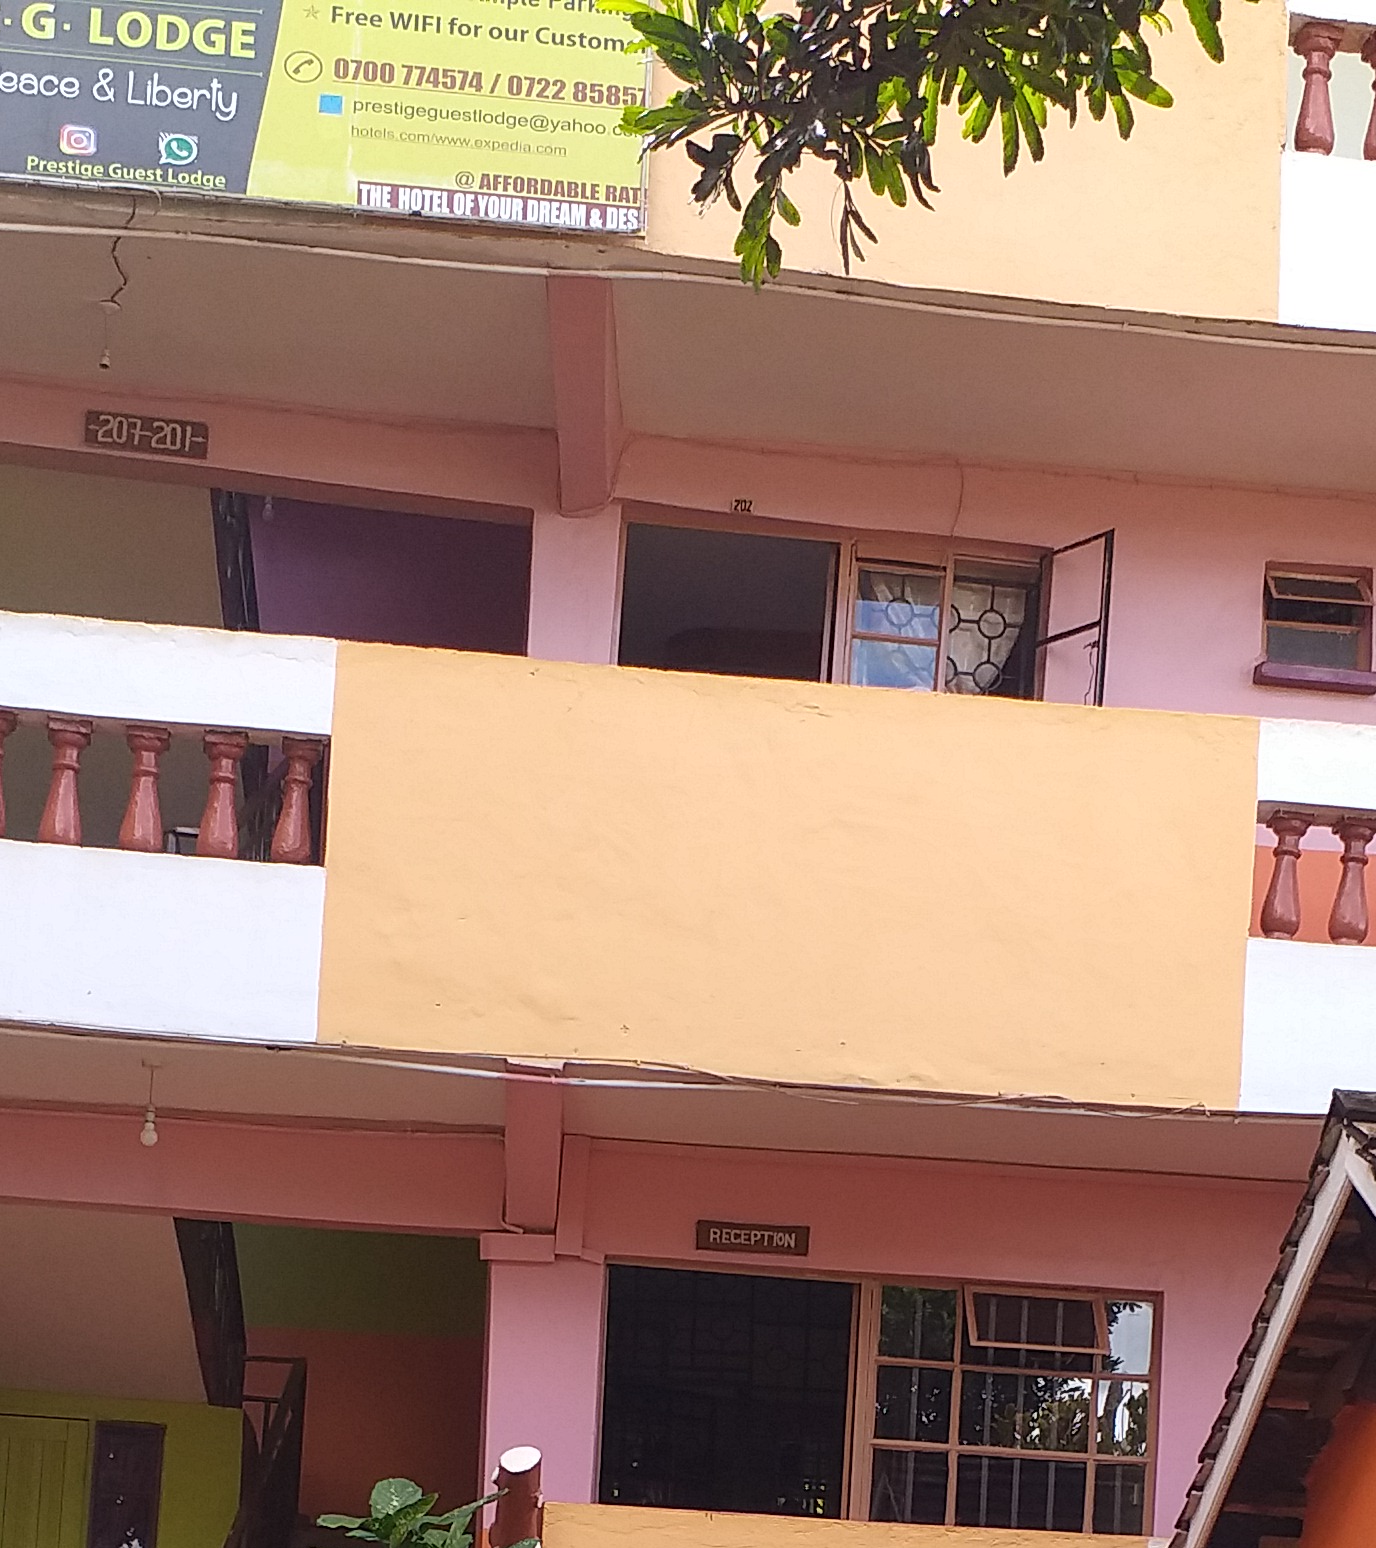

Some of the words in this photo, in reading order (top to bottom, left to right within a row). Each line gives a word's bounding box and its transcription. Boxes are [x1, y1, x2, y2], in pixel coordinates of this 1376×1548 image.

[88, 7, 256, 59] LODGE
[331, 5, 383, 28] Free
[389, 11, 442, 34] WIFI
[447, 17, 483, 38] for
[488, 26, 530, 42] our
[535, 26, 646, 54] Custom
[92, 68, 115, 102] &
[127, 70, 238, 121] Liberty
[334, 57, 395, 84] 0700
[401, 64, 484, 92] 774574
[489, 73, 502, 94] /
[507, 75, 567, 101] 0722
[353, 99, 638, 138] prestigeguestlodge@yahoo.c
[27, 155, 104, 180] Prestige
[109, 163, 163, 182] Guest
[168, 168, 226, 189] Lodge
[455, 171, 475, 189] @
[479, 173, 600, 201] AFFORDABLE
[359, 183, 392, 209] THE
[397, 187, 450, 215] HOTEL
[453, 192, 475, 216] OF
[477, 194, 524, 221] YOUR
[526, 199, 587, 227] DREAM
[589, 208, 603, 229] &
[709, 1228, 796, 1249] RECEPTION
